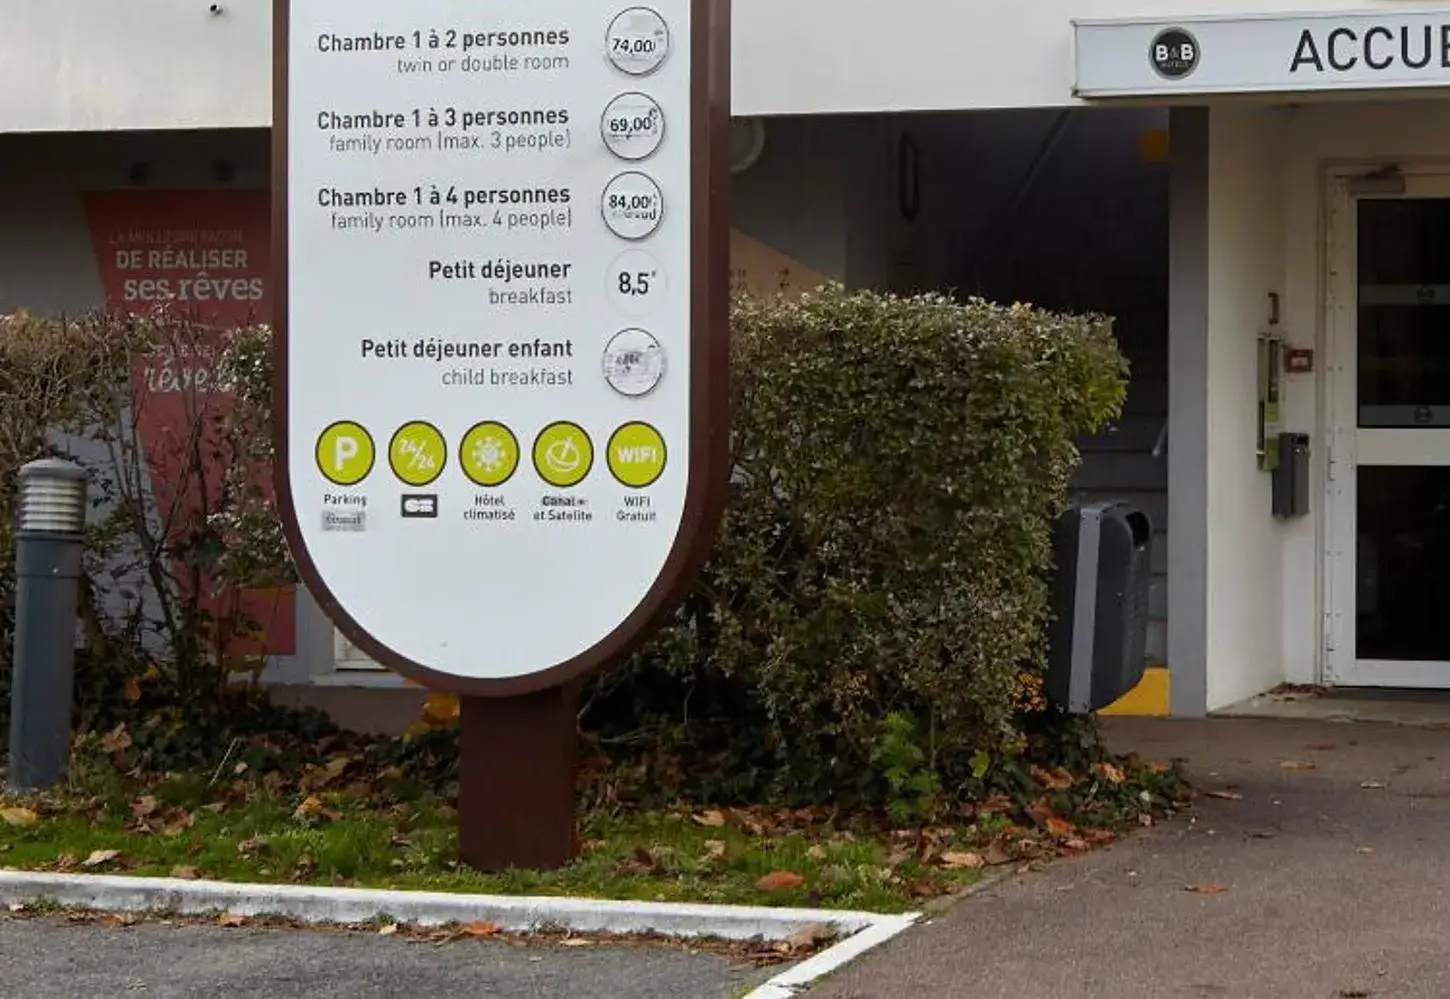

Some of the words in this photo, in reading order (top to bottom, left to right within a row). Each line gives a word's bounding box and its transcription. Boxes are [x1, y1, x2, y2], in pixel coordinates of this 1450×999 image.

[317, 32, 406, 52] Chambre
[412, 30, 421, 48] 1
[428, 29, 439, 48] à
[445, 30, 457, 48] 2
[463, 29, 570, 52] personnes
[397, 56, 432, 73] twin
[438, 59, 456, 72] or
[461, 53, 519, 72] double
[524, 56, 570, 71] room
[317, 110, 405, 129] Chambre
[411, 108, 420, 127] 1
[427, 107, 439, 127] à
[445, 107, 457, 126] 3
[462, 108, 570, 130] personnes
[329, 132, 381, 154] family
[386, 136, 432, 151] room
[491, 130, 501, 148] 3
[318, 187, 407, 207] Chambre
[413, 186, 422, 205] 1
[429, 185, 441, 205] à
[446, 186, 458, 204] 4
[464, 186, 571, 208] personnes
[331, 211, 384, 232] family
[389, 214, 434, 229] room
[492, 208, 502, 226] 4
[116, 250, 143, 269] DE
[148, 244, 248, 269] RÉALISER
[429, 259, 475, 280] Petit
[481, 257, 572, 283] déjeuner
[124, 277, 170, 301] ses
[177, 271, 264, 301] rêves
[489, 286, 572, 305] breakfast
[361, 338, 408, 359] Petit
[413, 336, 501, 363] déjeuner
[510, 338, 573, 358] enfant
[442, 369, 485, 386] child
[490, 368, 573, 386] breakfast
[615, 445, 657, 465] WIFI
[323, 493, 368, 507] Parking
[474, 494, 505, 507] Hôtel
[623, 495, 651, 507] WIFI
[463, 508, 516, 521] climatisé
[533, 509, 544, 521] et
[616, 509, 657, 522] Gratuit
